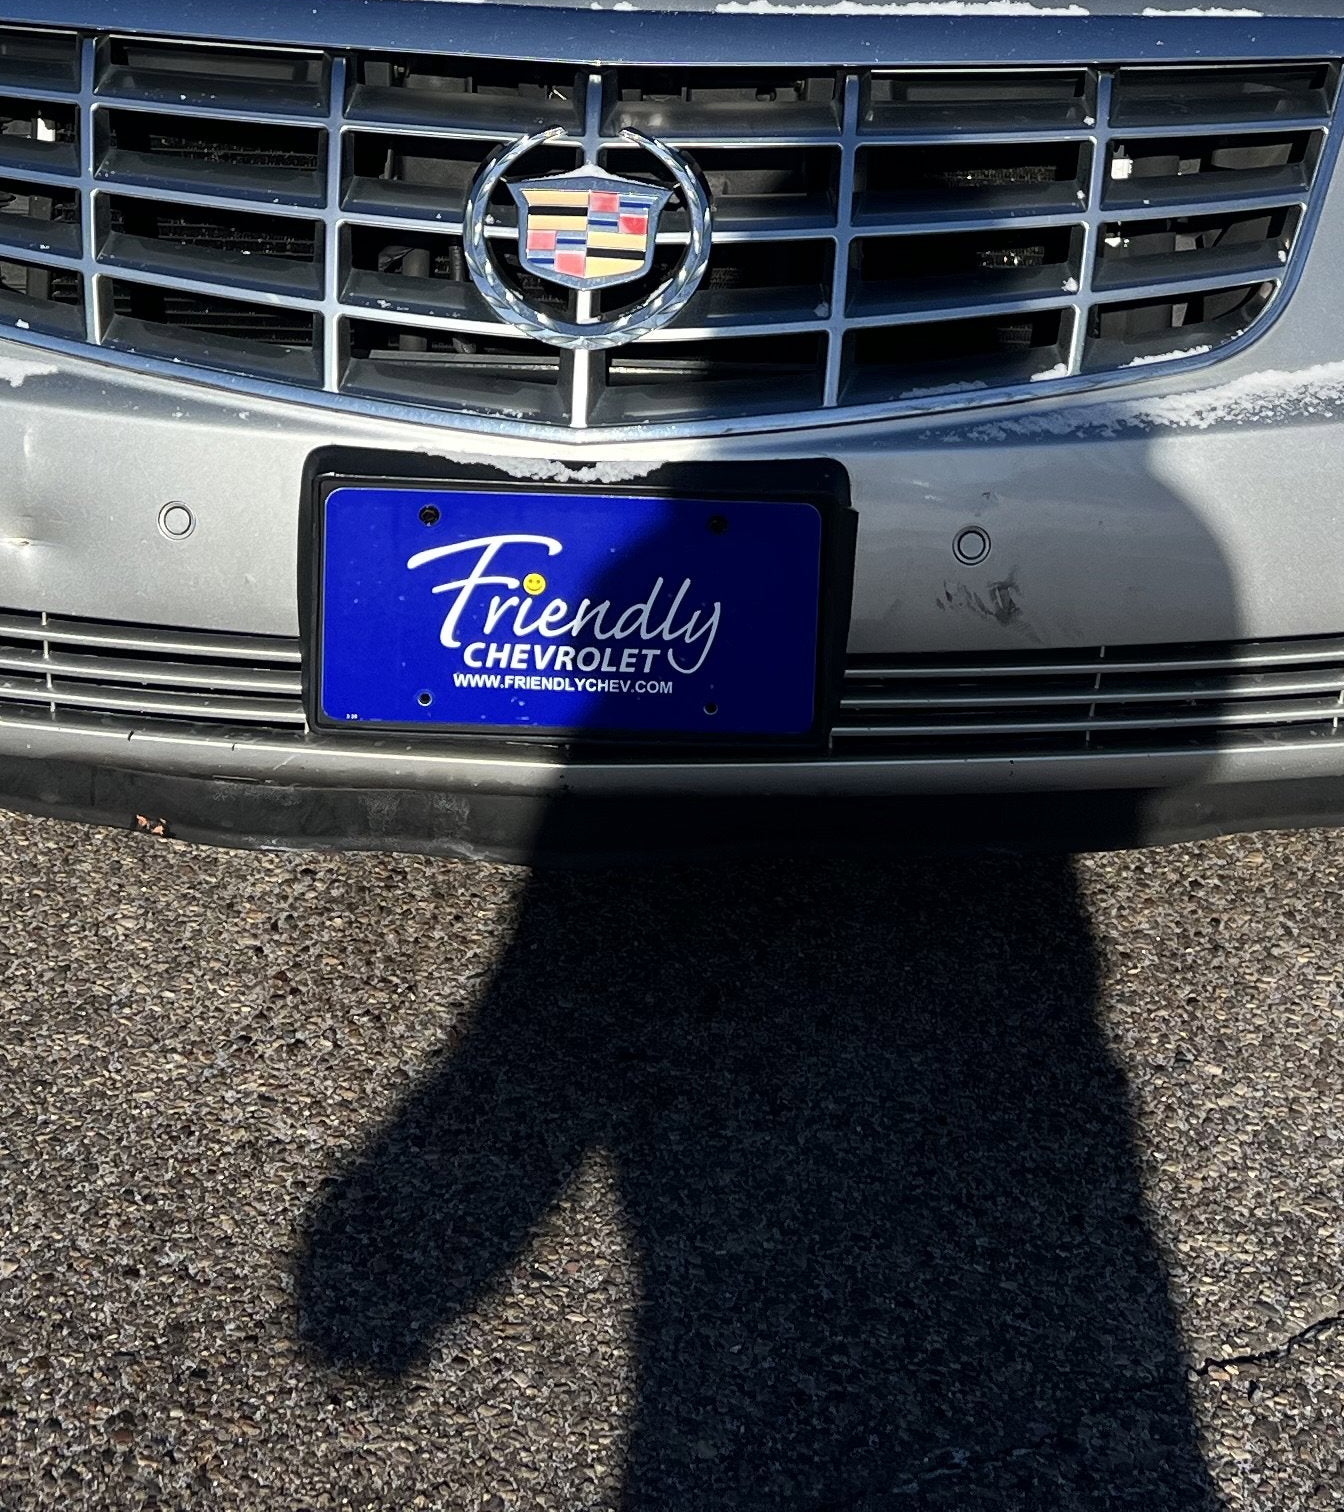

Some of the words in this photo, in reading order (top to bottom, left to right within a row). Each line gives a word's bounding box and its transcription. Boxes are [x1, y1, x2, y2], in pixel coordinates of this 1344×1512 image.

[406, 534, 722, 674] Friendly
[463, 641, 662, 674] CHEVROLET
[452, 672, 673, 694] WWW.FRIENDLYCHEV.COM
